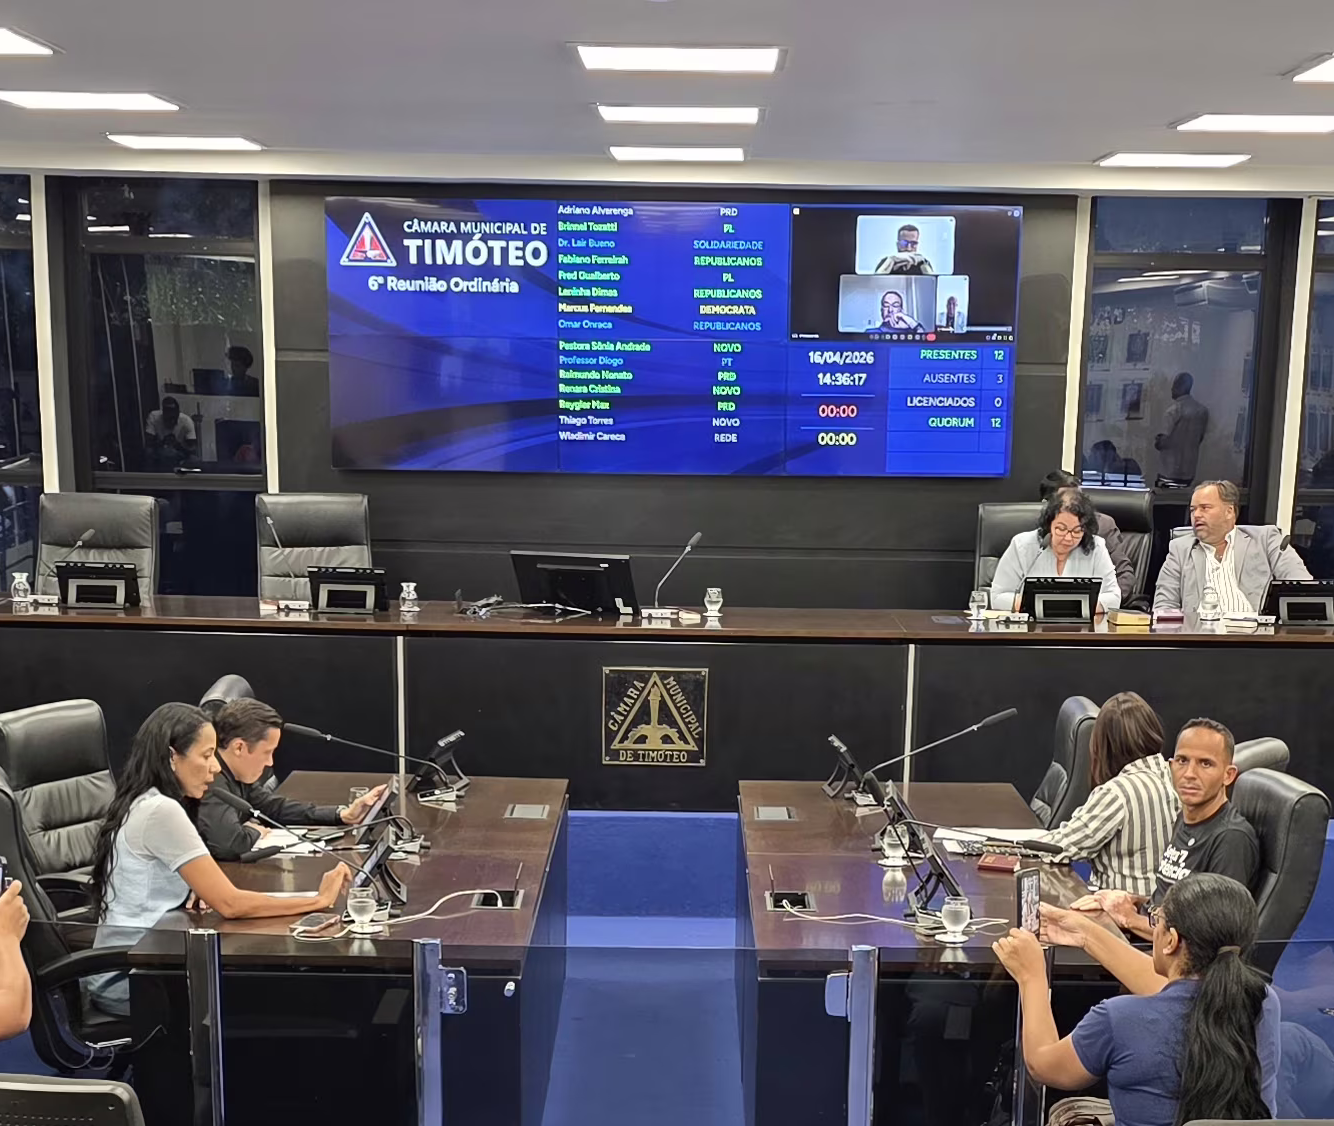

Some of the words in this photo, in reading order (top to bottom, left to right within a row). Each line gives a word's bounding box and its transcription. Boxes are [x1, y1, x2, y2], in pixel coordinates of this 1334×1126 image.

[719, 207, 738, 217] PRD
[403, 218, 457, 234] CÂMARA
[460, 221, 528, 235] MUNICIPAL
[530, 223, 548, 235] DE
[558, 238, 570, 248] Dr.
[693, 239, 764, 250] SOLIDARIEDADE
[403, 234, 549, 267] TIMÓTEO
[693, 256, 763, 267] REPUBLICANOS
[558, 270, 578, 281] Fred
[722, 273, 735, 283] PL
[386, 276, 448, 292] Reunião
[449, 277, 520, 293] Ordinária
[693, 288, 763, 299] REPUBLICANOS
[699, 305, 757, 315] DEMOCRATA
[558, 319, 581, 329] Omar
[693, 321, 762, 331] REPUBLICANOS
[713, 342, 742, 353] NOVO
[808, 350, 875, 365] 16/04/2026
[919, 349, 978, 361] PRESENTES
[993, 350, 1005, 361] 12
[558, 355, 598, 365] Professor
[598, 356, 624, 367] Diogo
[721, 357, 734, 367] PT
[558, 369, 600, 380] Raimundo
[717, 371, 737, 382] PRD
[817, 372, 867, 387] 14:36:17
[923, 373, 976, 384] AUSENTES
[996, 374, 1004, 384] 3
[712, 385, 741, 396] NOVO
[717, 401, 736, 411] PRD
[907, 396, 976, 408] LICENCIADOS
[994, 397, 1003, 408] 0
[818, 404, 858, 418] 00:00
[558, 415, 587, 427] Thiago
[587, 416, 614, 425] Torres
[712, 417, 741, 427] NOVO
[928, 417, 975, 428] QUORUM
[990, 417, 1002, 428] 12
[558, 431, 595, 441] Wladimir
[714, 433, 738, 443] REDE
[817, 432, 857, 446] 00:00
[608, 680, 645, 731] CÂMARA
[664, 675, 703, 738] MUNICIPAL
[619, 750, 634, 761] DE
[637, 750, 688, 762] TIMÓTEO
